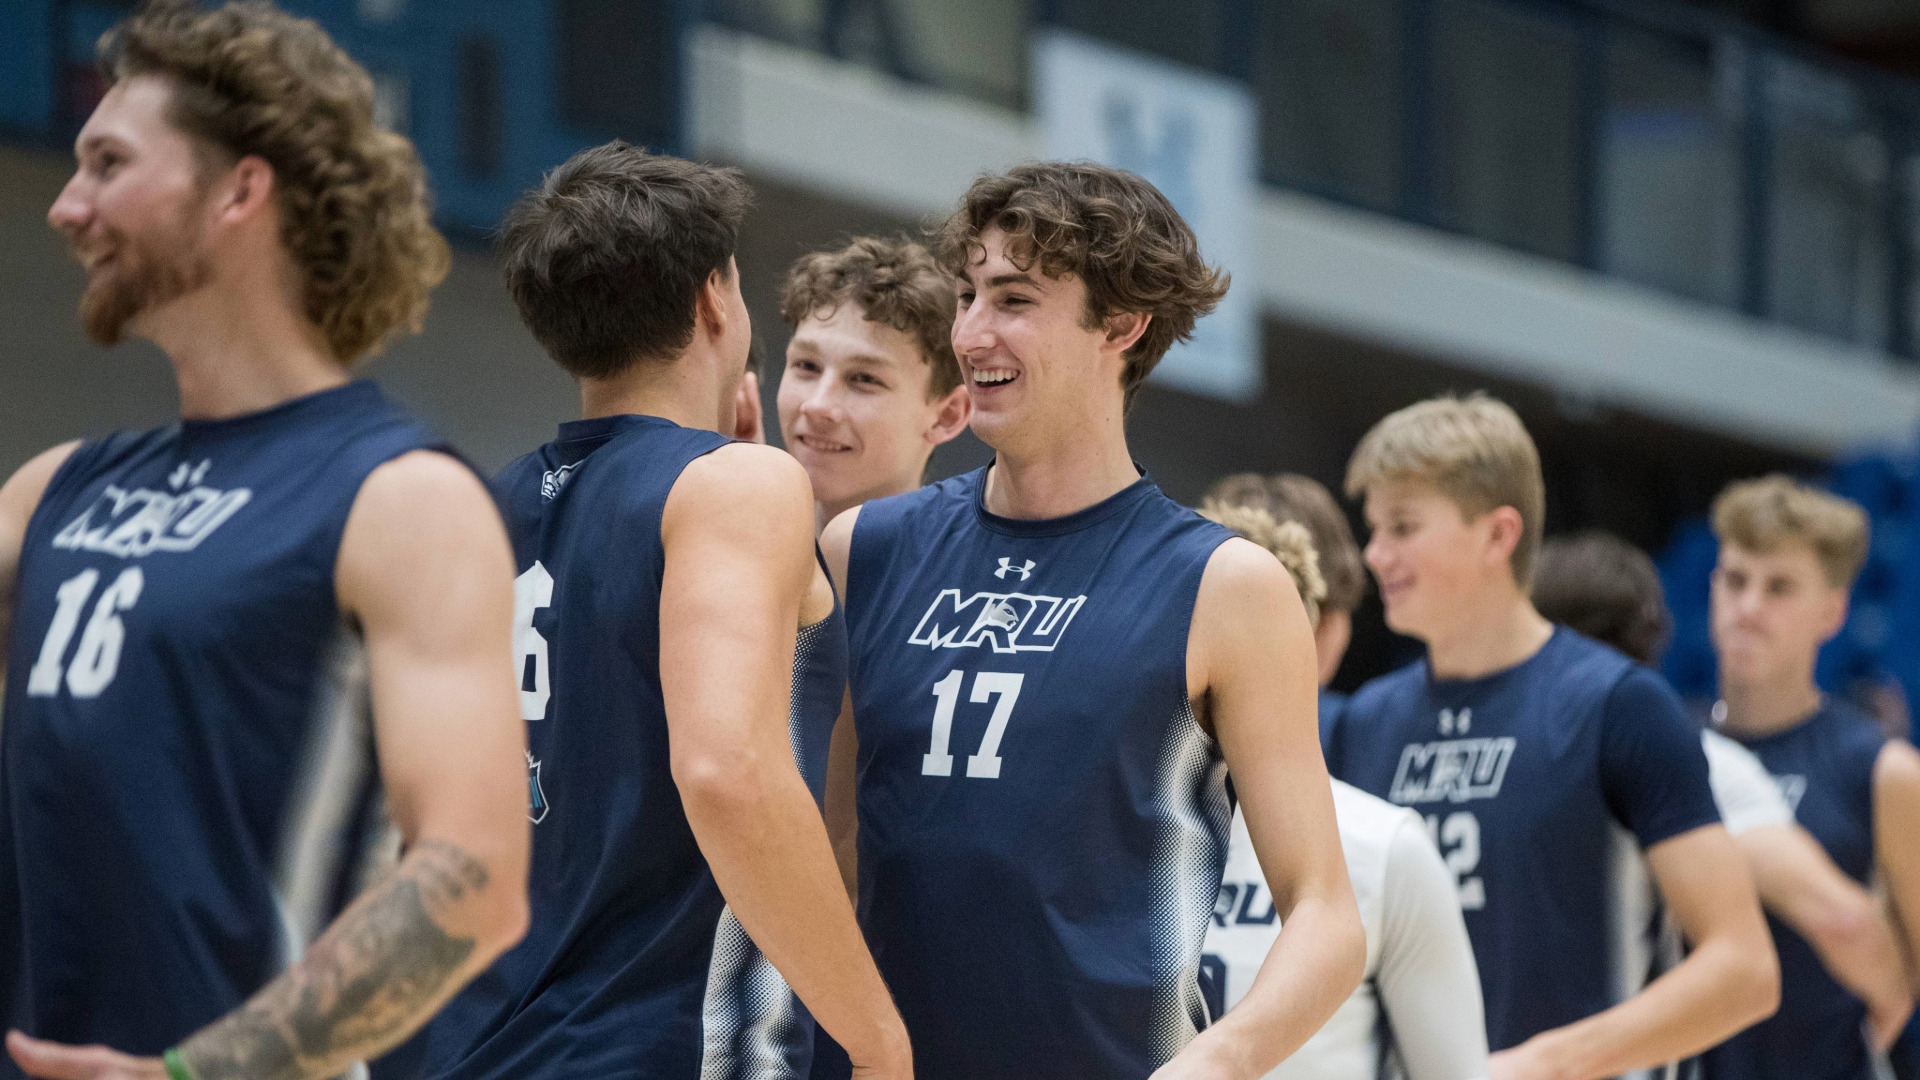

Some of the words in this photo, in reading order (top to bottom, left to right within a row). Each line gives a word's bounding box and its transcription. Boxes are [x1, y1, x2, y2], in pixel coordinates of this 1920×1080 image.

[27, 566, 144, 698] 16
[907, 588, 1088, 653] MRU
[921, 669, 1025, 778] 17
[1388, 736, 1517, 804] MRU
